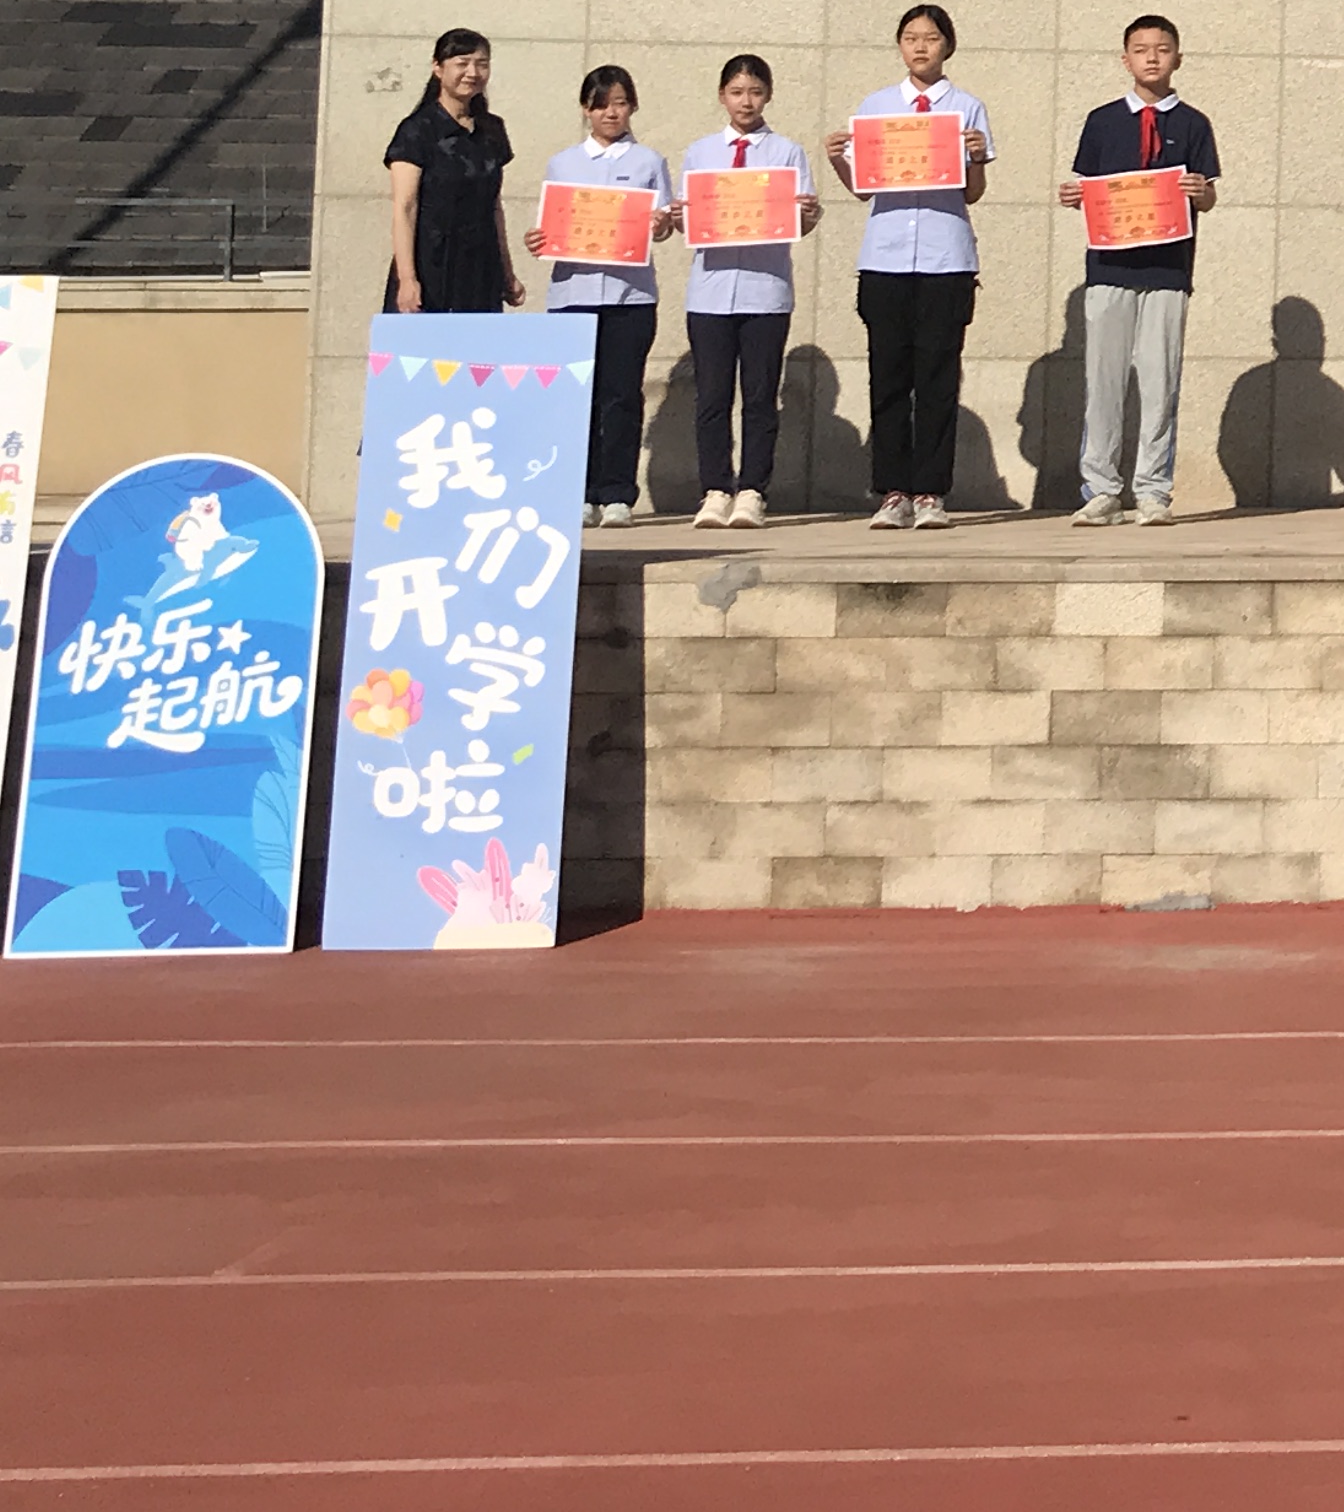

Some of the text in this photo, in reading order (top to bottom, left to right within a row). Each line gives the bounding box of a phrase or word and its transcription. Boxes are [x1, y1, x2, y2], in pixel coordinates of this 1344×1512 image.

[58, 597, 213, 695] 快乐
[359, 407, 571, 834] 我们开学啦
[106, 650, 303, 753] 起航
